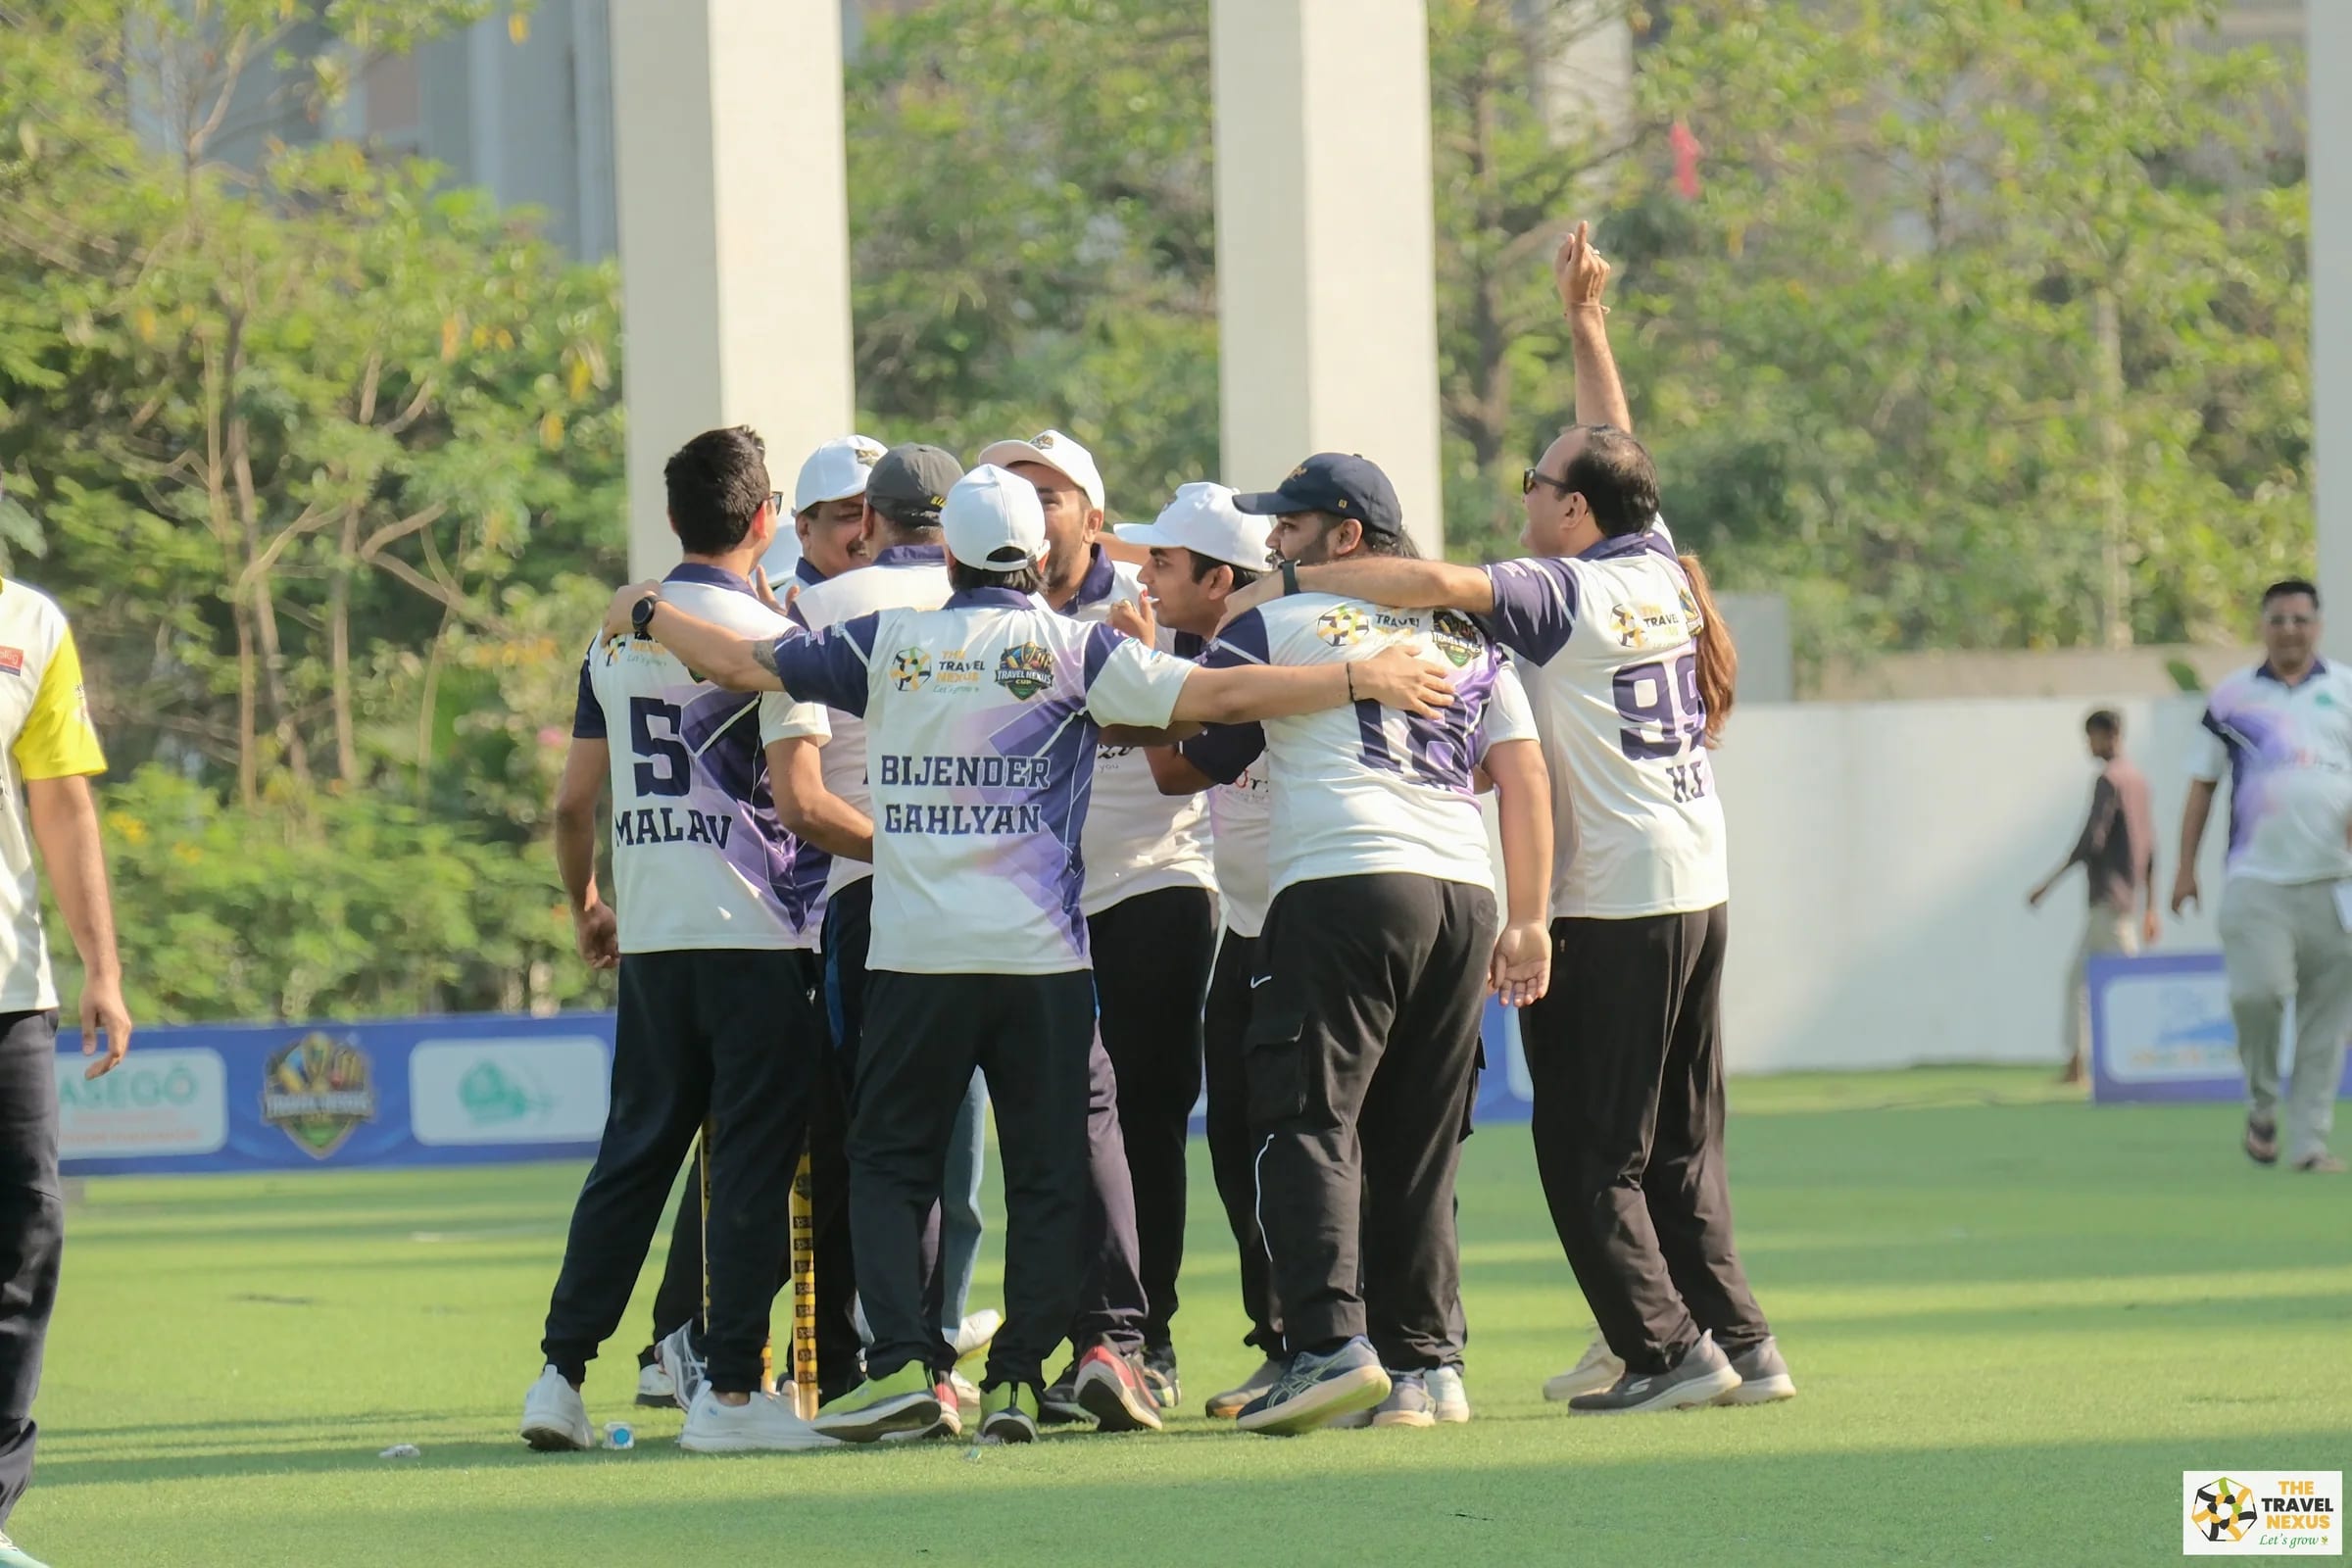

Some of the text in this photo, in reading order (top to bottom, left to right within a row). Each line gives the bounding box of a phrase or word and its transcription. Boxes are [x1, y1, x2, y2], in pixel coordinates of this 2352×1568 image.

[939, 661, 985, 672] TRAVEL
[998, 669, 1052, 684] TRAVEL NEXUS
[630, 697, 691, 797] 5
[881, 755, 1051, 788] BIJENDER
[614, 808, 732, 850] MALAV
[885, 804, 1042, 835] GAHLYAN
